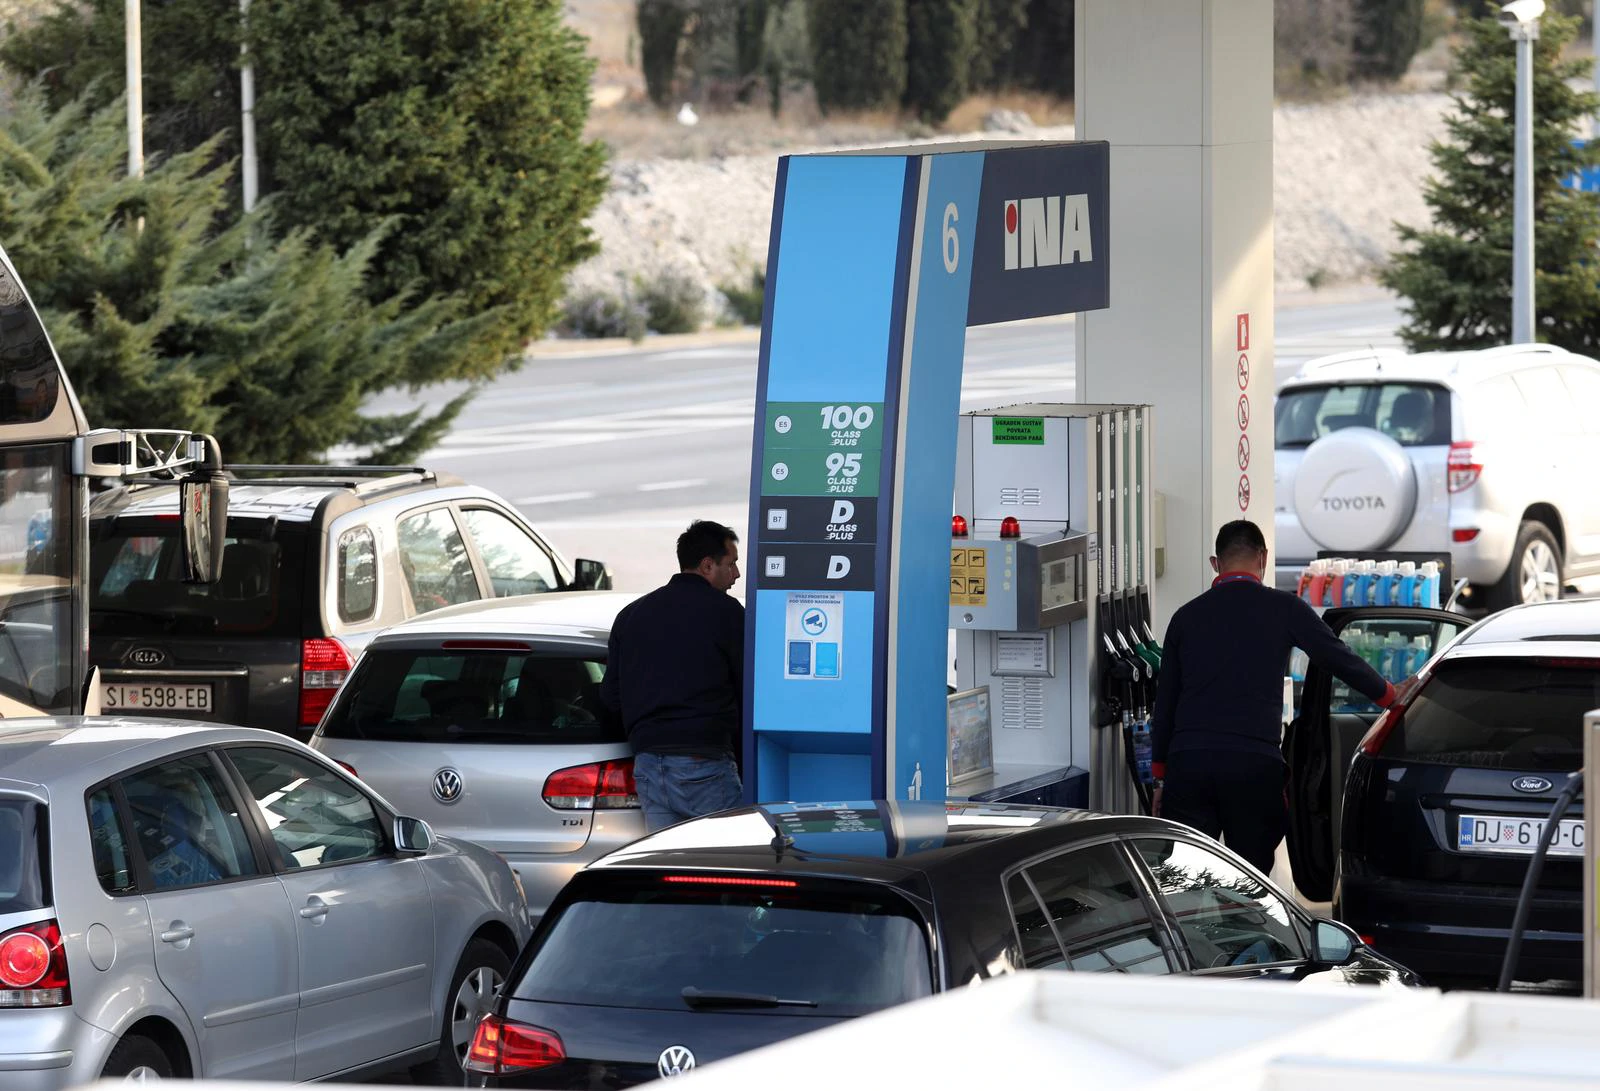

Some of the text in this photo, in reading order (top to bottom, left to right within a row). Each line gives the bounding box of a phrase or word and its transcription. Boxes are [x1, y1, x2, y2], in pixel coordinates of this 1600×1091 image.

[942, 202, 959, 274] 6
[820, 405, 874, 430] 100
[831, 430, 861, 438] CLASS
[833, 438, 858, 446] PLUS
[825, 452, 862, 477] 95
[827, 477, 858, 485] CLASS
[830, 485, 854, 493] PLUS
[1322, 495, 1385, 511] TOYOTA
[830, 499, 855, 524] D
[826, 524, 858, 532] CLASS
[829, 532, 854, 540] PLUS
[826, 555, 851, 580] D
[135, 651, 158, 663] KIA
[106, 686, 124, 706] SI
[1520, 779, 1542, 789] Ford
[1461, 834, 1472, 842] HR
[1475, 820, 1501, 843] DJ
